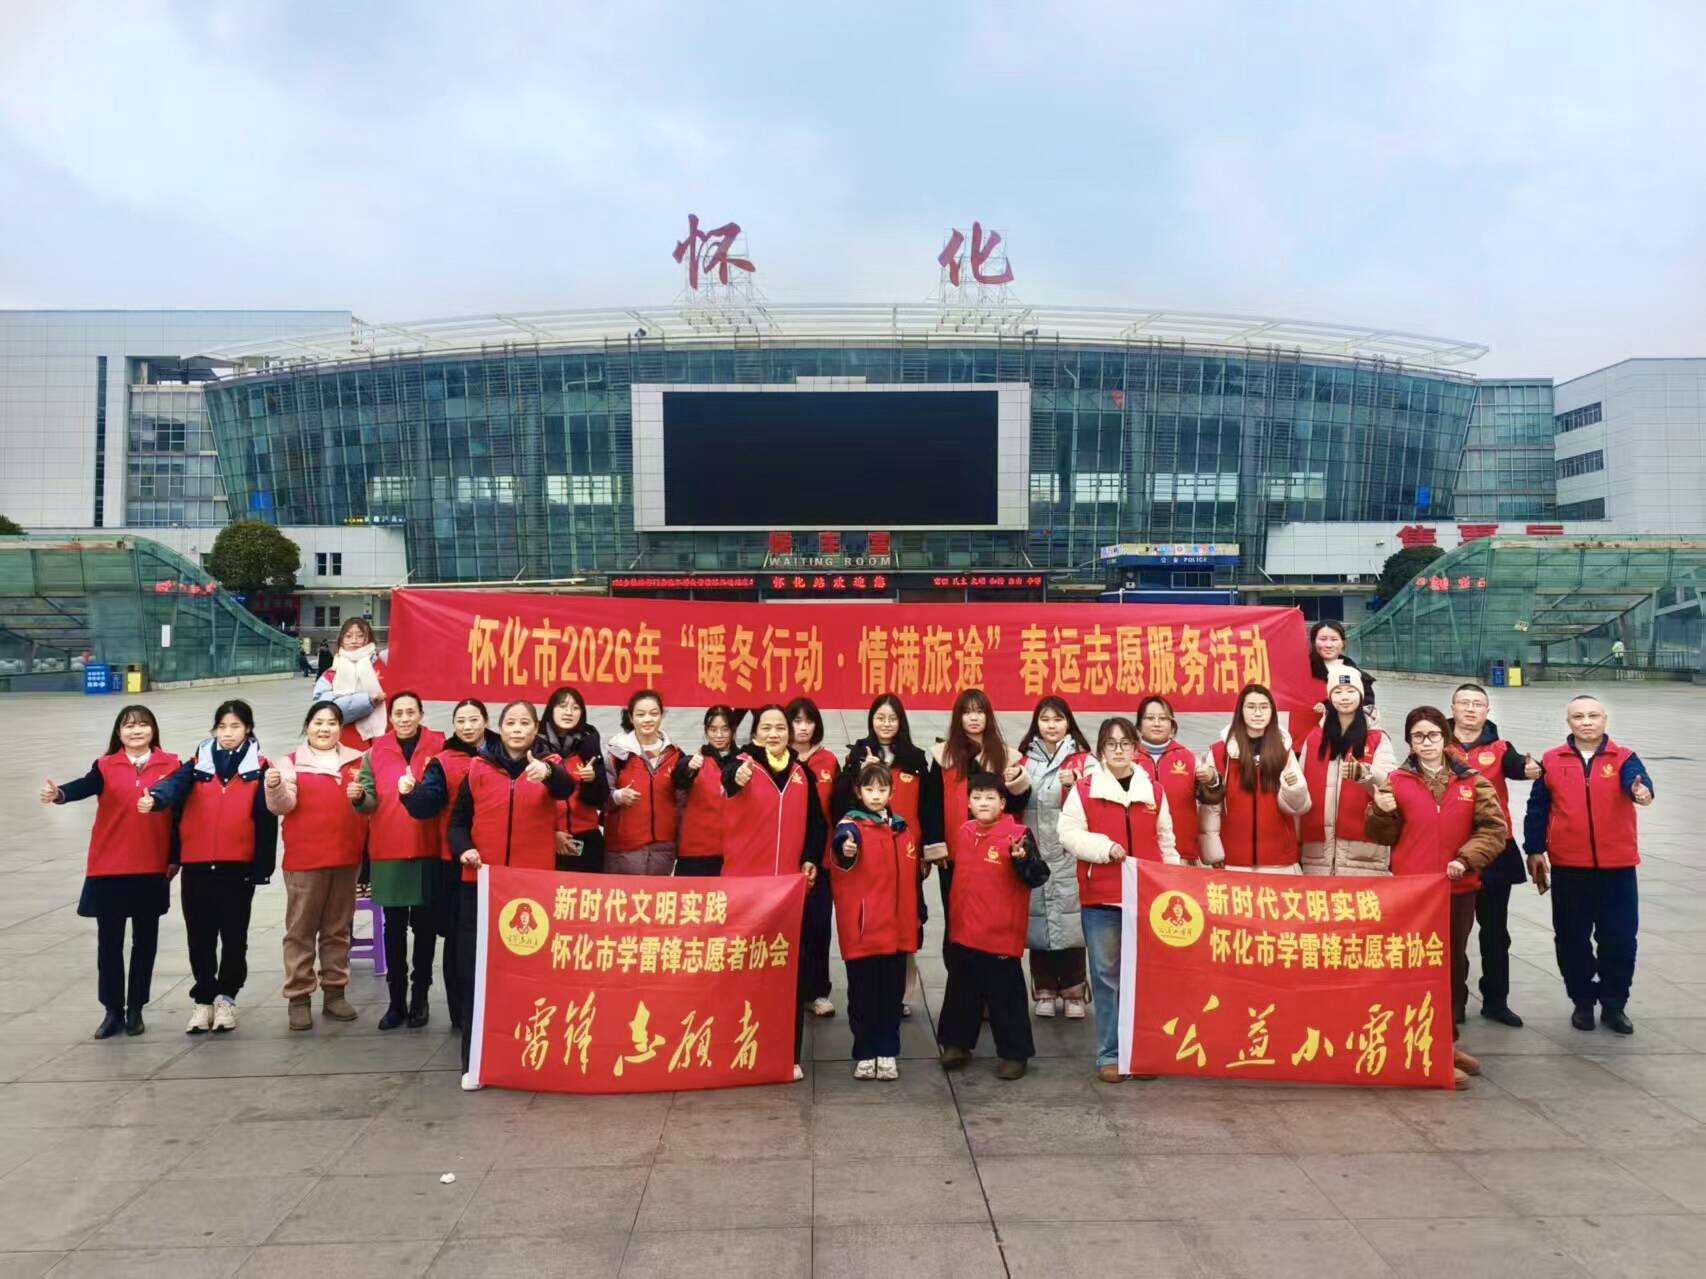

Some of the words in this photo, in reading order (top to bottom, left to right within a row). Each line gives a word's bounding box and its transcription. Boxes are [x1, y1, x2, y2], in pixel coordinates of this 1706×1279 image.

[672, 213, 1014, 290] 怀化
[769, 557, 833, 566] WAITING
[844, 557, 891, 566] ROOM
[553, 885, 728, 925] 新时代文明实践
[1206, 881, 1382, 923] 新时代文明实践
[550, 931, 790, 974] 怀化市学雷锋志愿者协会
[1209, 926, 1444, 970] 怀化市学雷锋志愿者协会
[514, 991, 759, 1077] 雷锋志愿者
